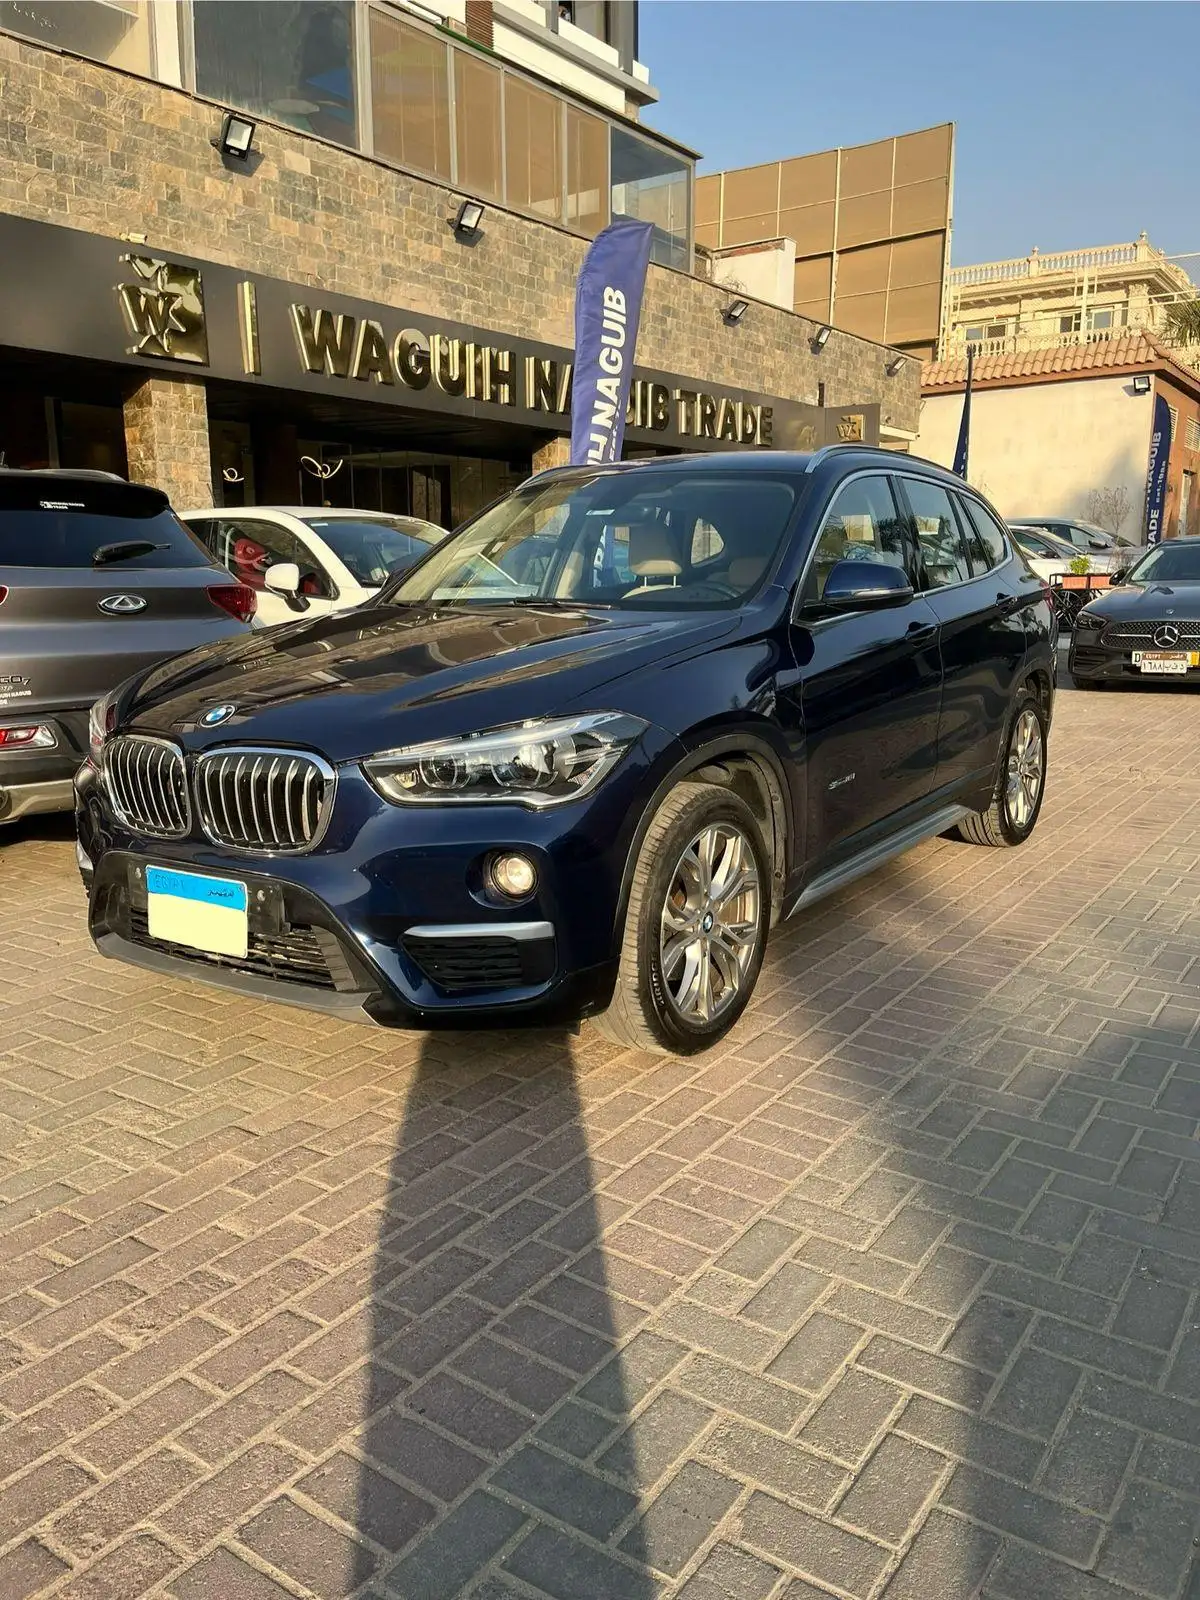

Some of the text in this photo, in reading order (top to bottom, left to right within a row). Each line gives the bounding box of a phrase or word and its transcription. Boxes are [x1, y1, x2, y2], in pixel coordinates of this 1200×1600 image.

[290, 303, 517, 407] WAGUIH
[673, 388, 773, 447] TRADE
[592, 286, 626, 429] NAGUIB
